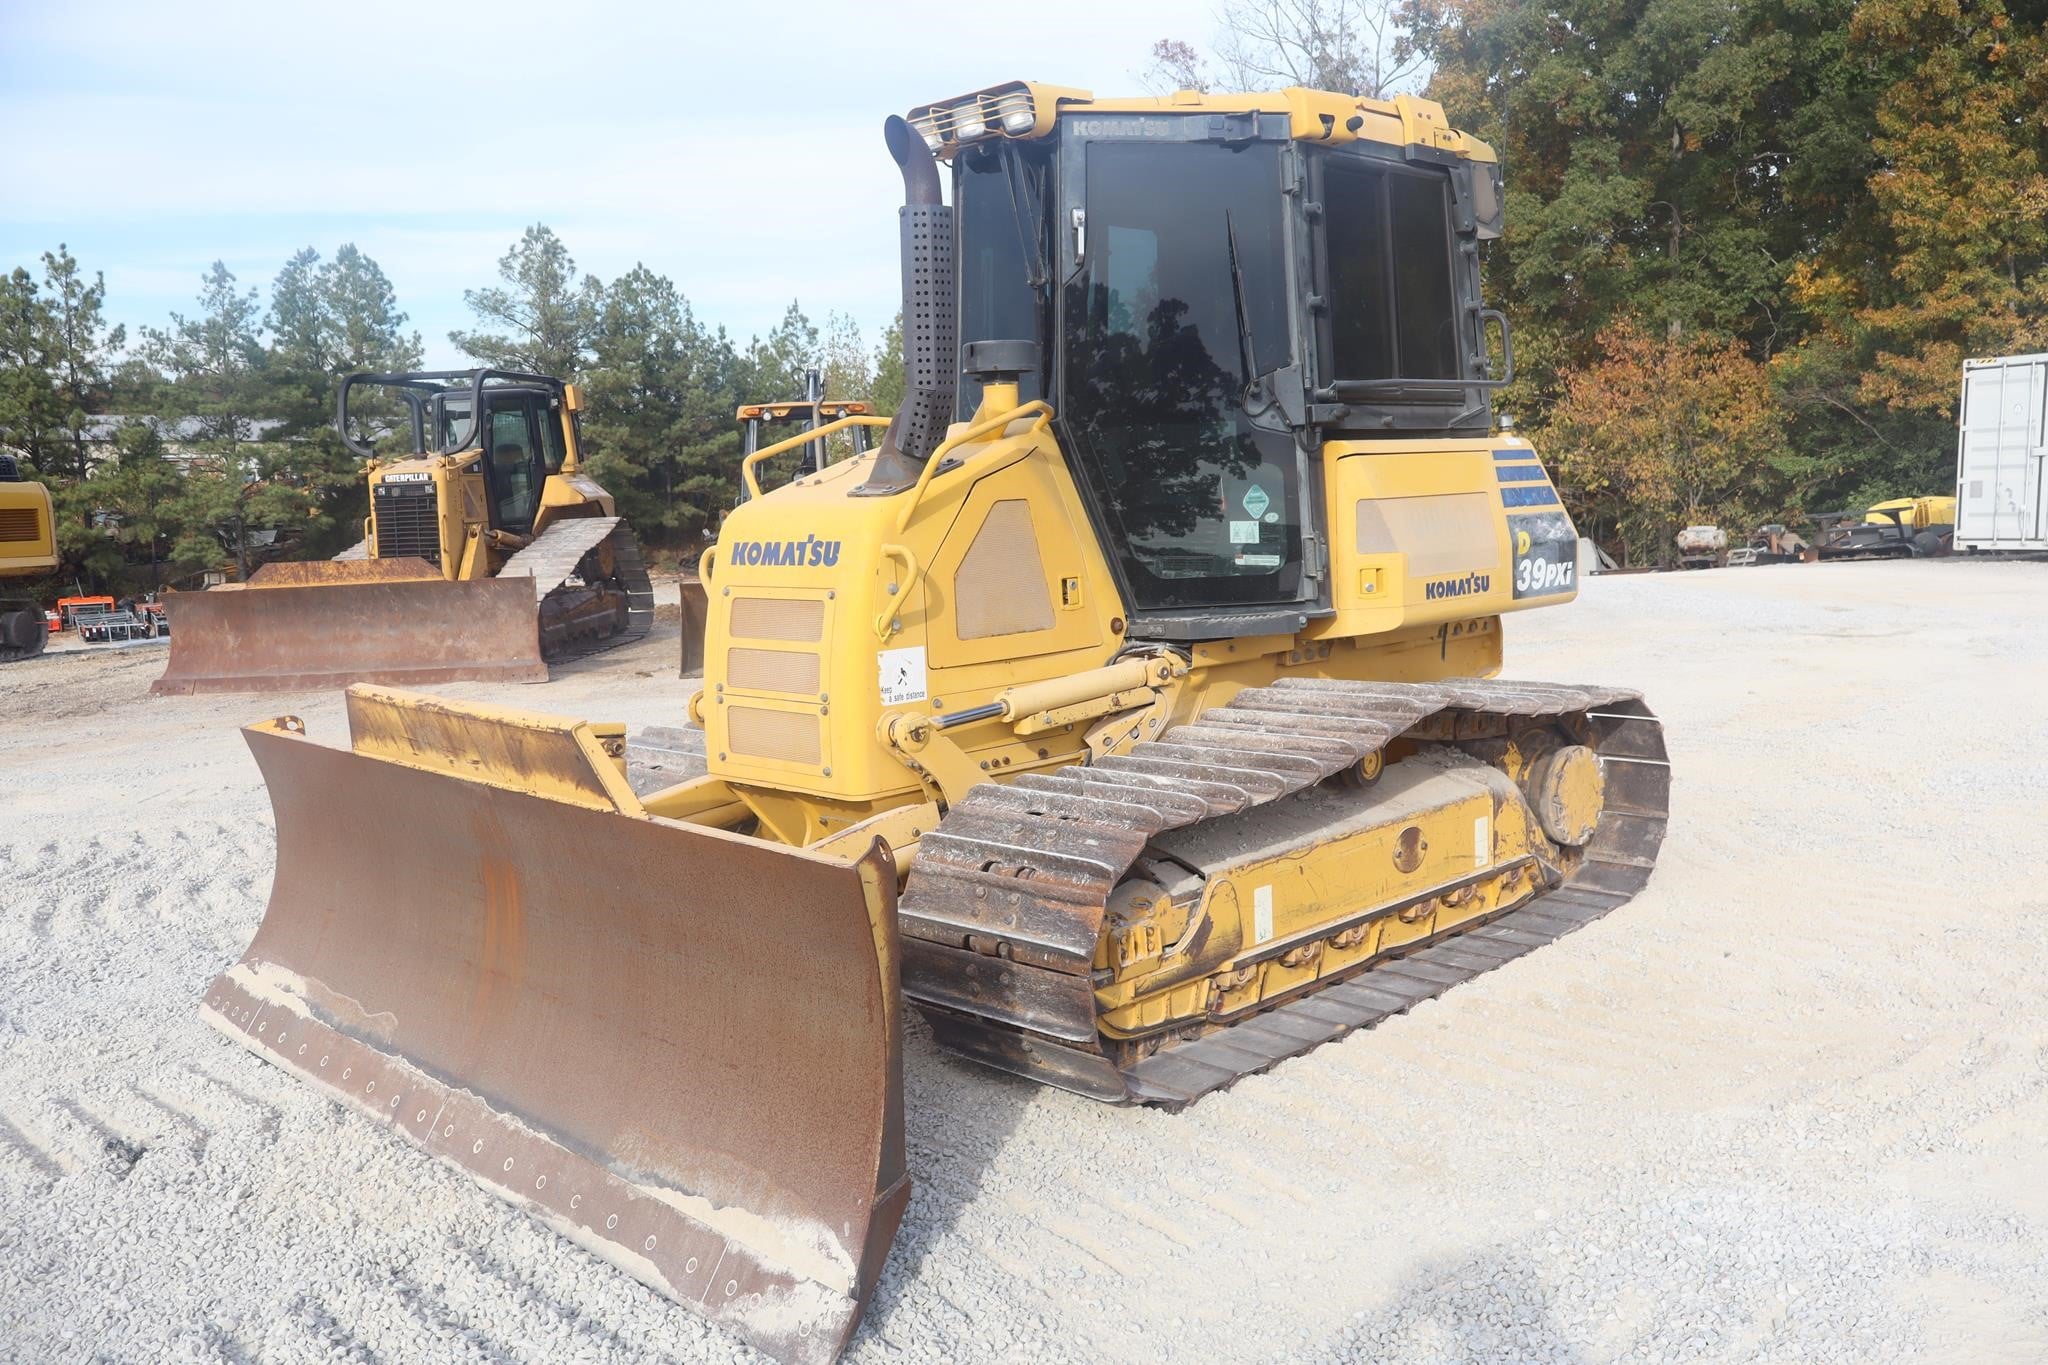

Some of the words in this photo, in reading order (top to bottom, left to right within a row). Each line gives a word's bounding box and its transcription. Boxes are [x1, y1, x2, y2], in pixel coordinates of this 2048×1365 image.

[1072, 117, 1169, 136] KOMATSU
[384, 473, 429, 482] CATERPILLAR
[730, 533, 841, 567] KOMATSU
[1516, 531, 1531, 555] D
[1425, 572, 1490, 600] KOMATSU
[1516, 558, 1573, 592] 39PXi
[906, 690, 925, 699] distance
